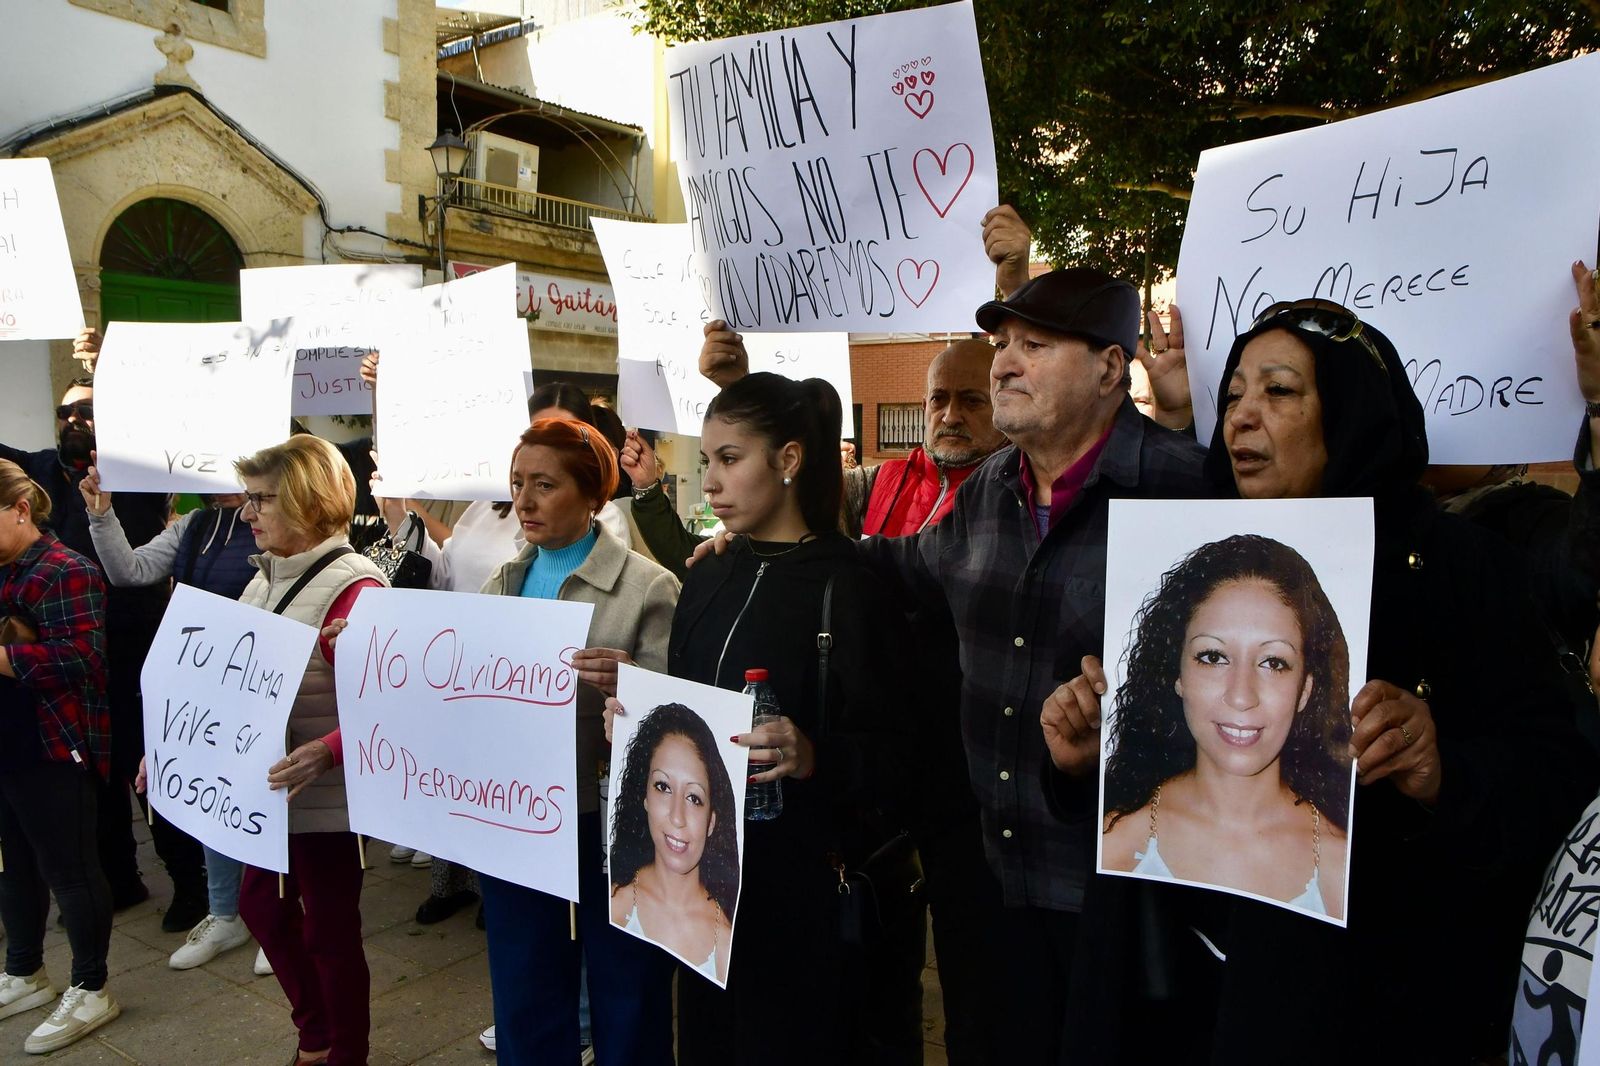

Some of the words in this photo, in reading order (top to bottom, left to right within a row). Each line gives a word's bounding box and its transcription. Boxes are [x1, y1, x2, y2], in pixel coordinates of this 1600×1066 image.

[669, 66, 705, 161] TU
[709, 35, 829, 160] FAMILIA
[826, 24, 857, 130] Y
[687, 166, 784, 254] AMIGOS
[792, 156, 846, 246] NO
[861, 147, 919, 241] TE
[547, 282, 618, 323] Gaitán
[717, 239, 896, 330] OLVIDAREMOS
[1312, 262, 1470, 310] MERECE
[1403, 358, 1544, 416] MADRE
[164, 449, 223, 475] VOZ
[177, 626, 214, 668] TU
[220, 630, 285, 705] ALMA
[358, 625, 408, 699] NO
[235, 723, 262, 756] EN
[358, 723, 395, 777] NO
[400, 745, 567, 832] PERDONAMOS
[151, 748, 268, 837] NOSOTROS
